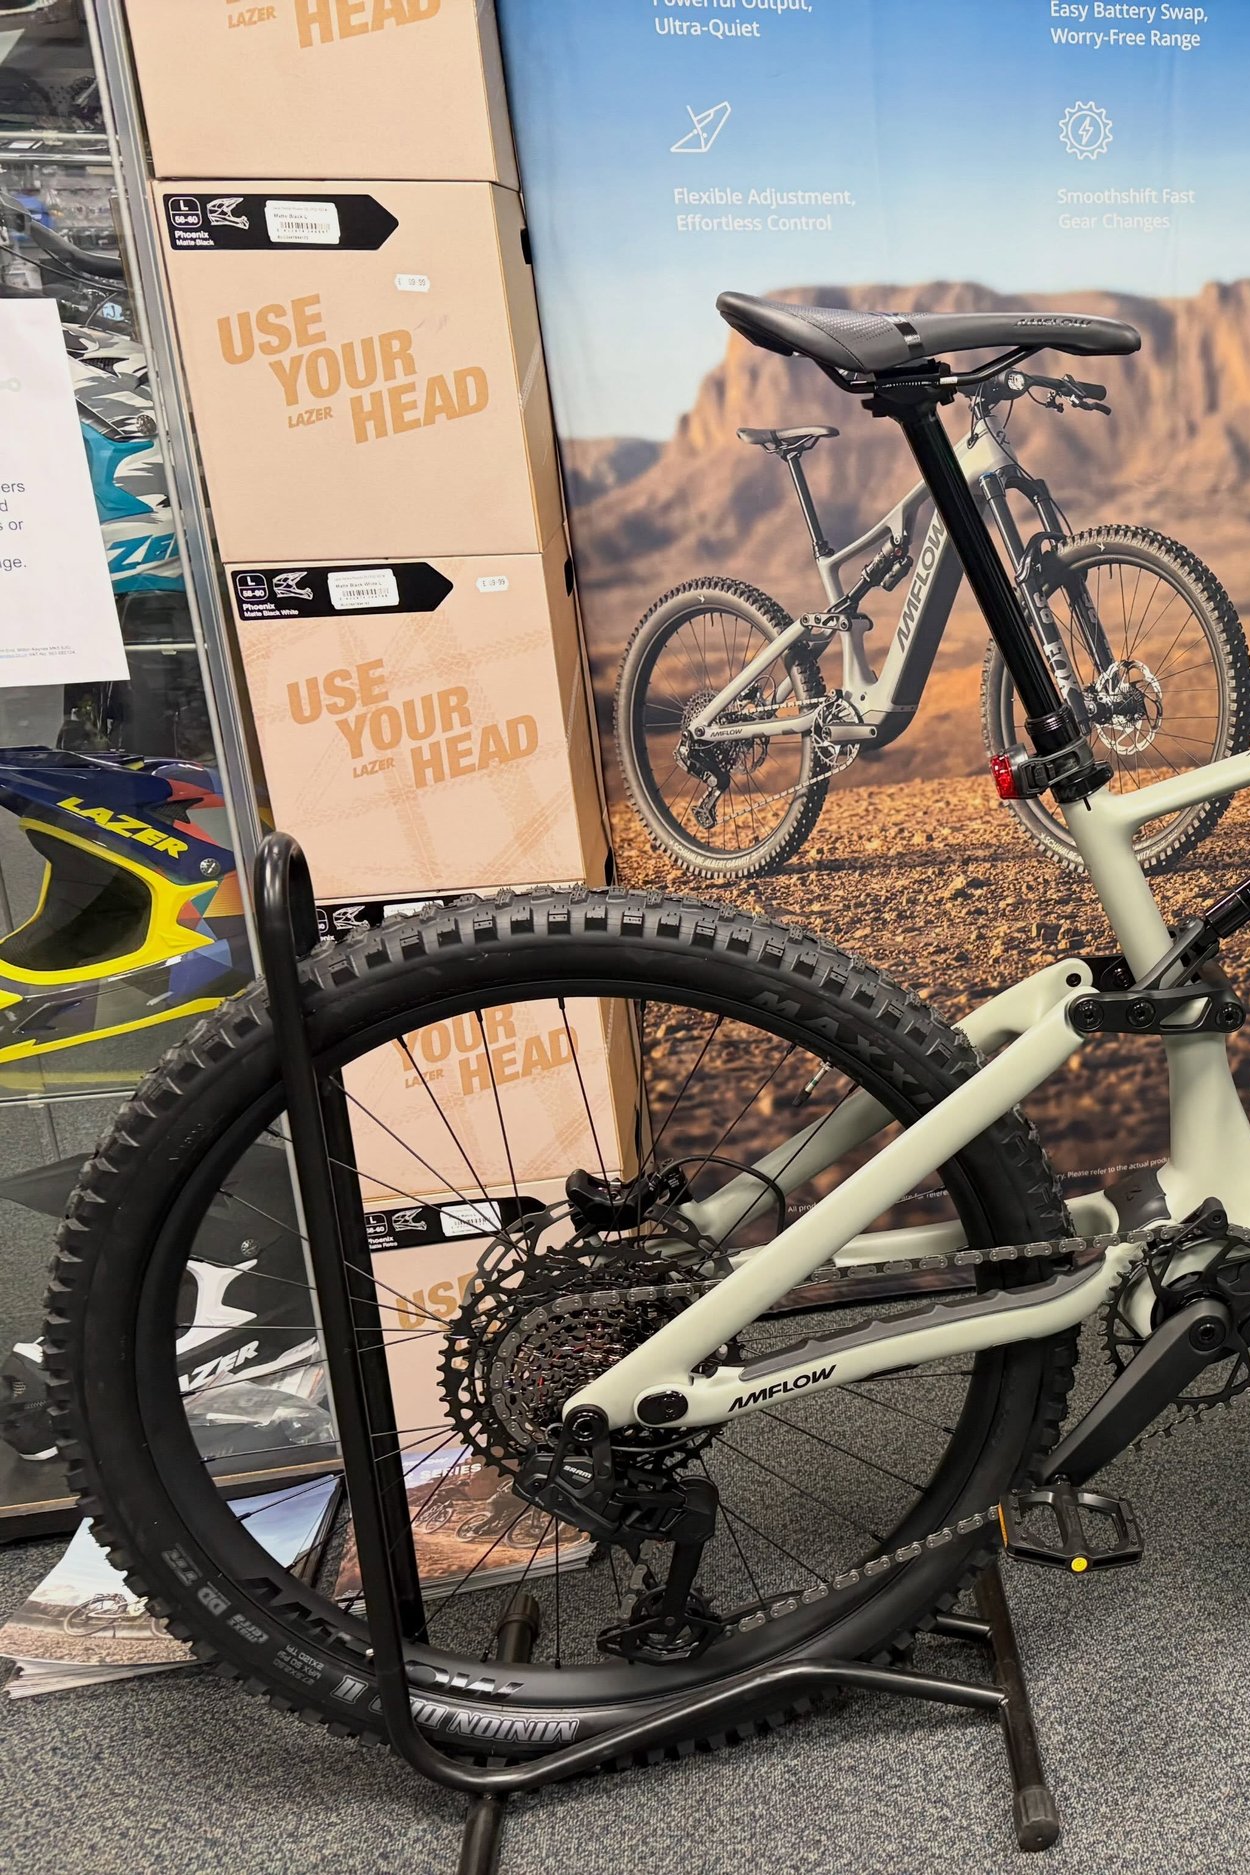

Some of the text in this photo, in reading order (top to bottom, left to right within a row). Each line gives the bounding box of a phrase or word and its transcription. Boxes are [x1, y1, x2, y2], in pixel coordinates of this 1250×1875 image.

[228, 6, 276, 28] LAZER
[1050, 1, 1208, 24] Easy Battery Swap,
[655, 18, 760, 39] Ultra-Quiet
[1051, 28, 1200, 50] Worry-Free Range
[179, 200, 189, 211] L
[673, 188, 856, 209] Flexible Adjustment,
[1057, 188, 1196, 204] Smoothshift Fast
[677, 214, 832, 231] Effortless Control
[1059, 214, 1170, 232] Gear Changes
[175, 230, 209, 239] Phoenix
[217, 293, 327, 365] USE
[268, 329, 418, 407] YOUR
[349, 366, 489, 444] HEAD
[287, 406, 333, 429] LAZER
[0, 558, 27, 572] ge.
[247, 576, 255, 585] L
[287, 658, 389, 725] USE
[335, 686, 472, 760] YOUR
[410, 714, 539, 789] HEAD
[352, 757, 396, 779] LAZER
[56, 796, 189, 859] LAZER
[391, 1005, 517, 1072] YOUR
[750, 990, 936, 1105] MAXXI
[458, 1026, 579, 1096] HEAD
[405, 1068, 444, 1089] LAZER
[1067, 1170, 1089, 1179] Please
[1090, 1168, 1106, 1176] refer
[1128, 1160, 1149, 1170] actual
[1149, 1157, 1169, 1168] produ
[178, 1340, 260, 1392] ZER
[728, 1364, 837, 1413] AMFLOW
[420, 1463, 483, 1481] SERIES
[562, 1464, 593, 1479] SRAM
[448, 1710, 580, 1743] MINION
